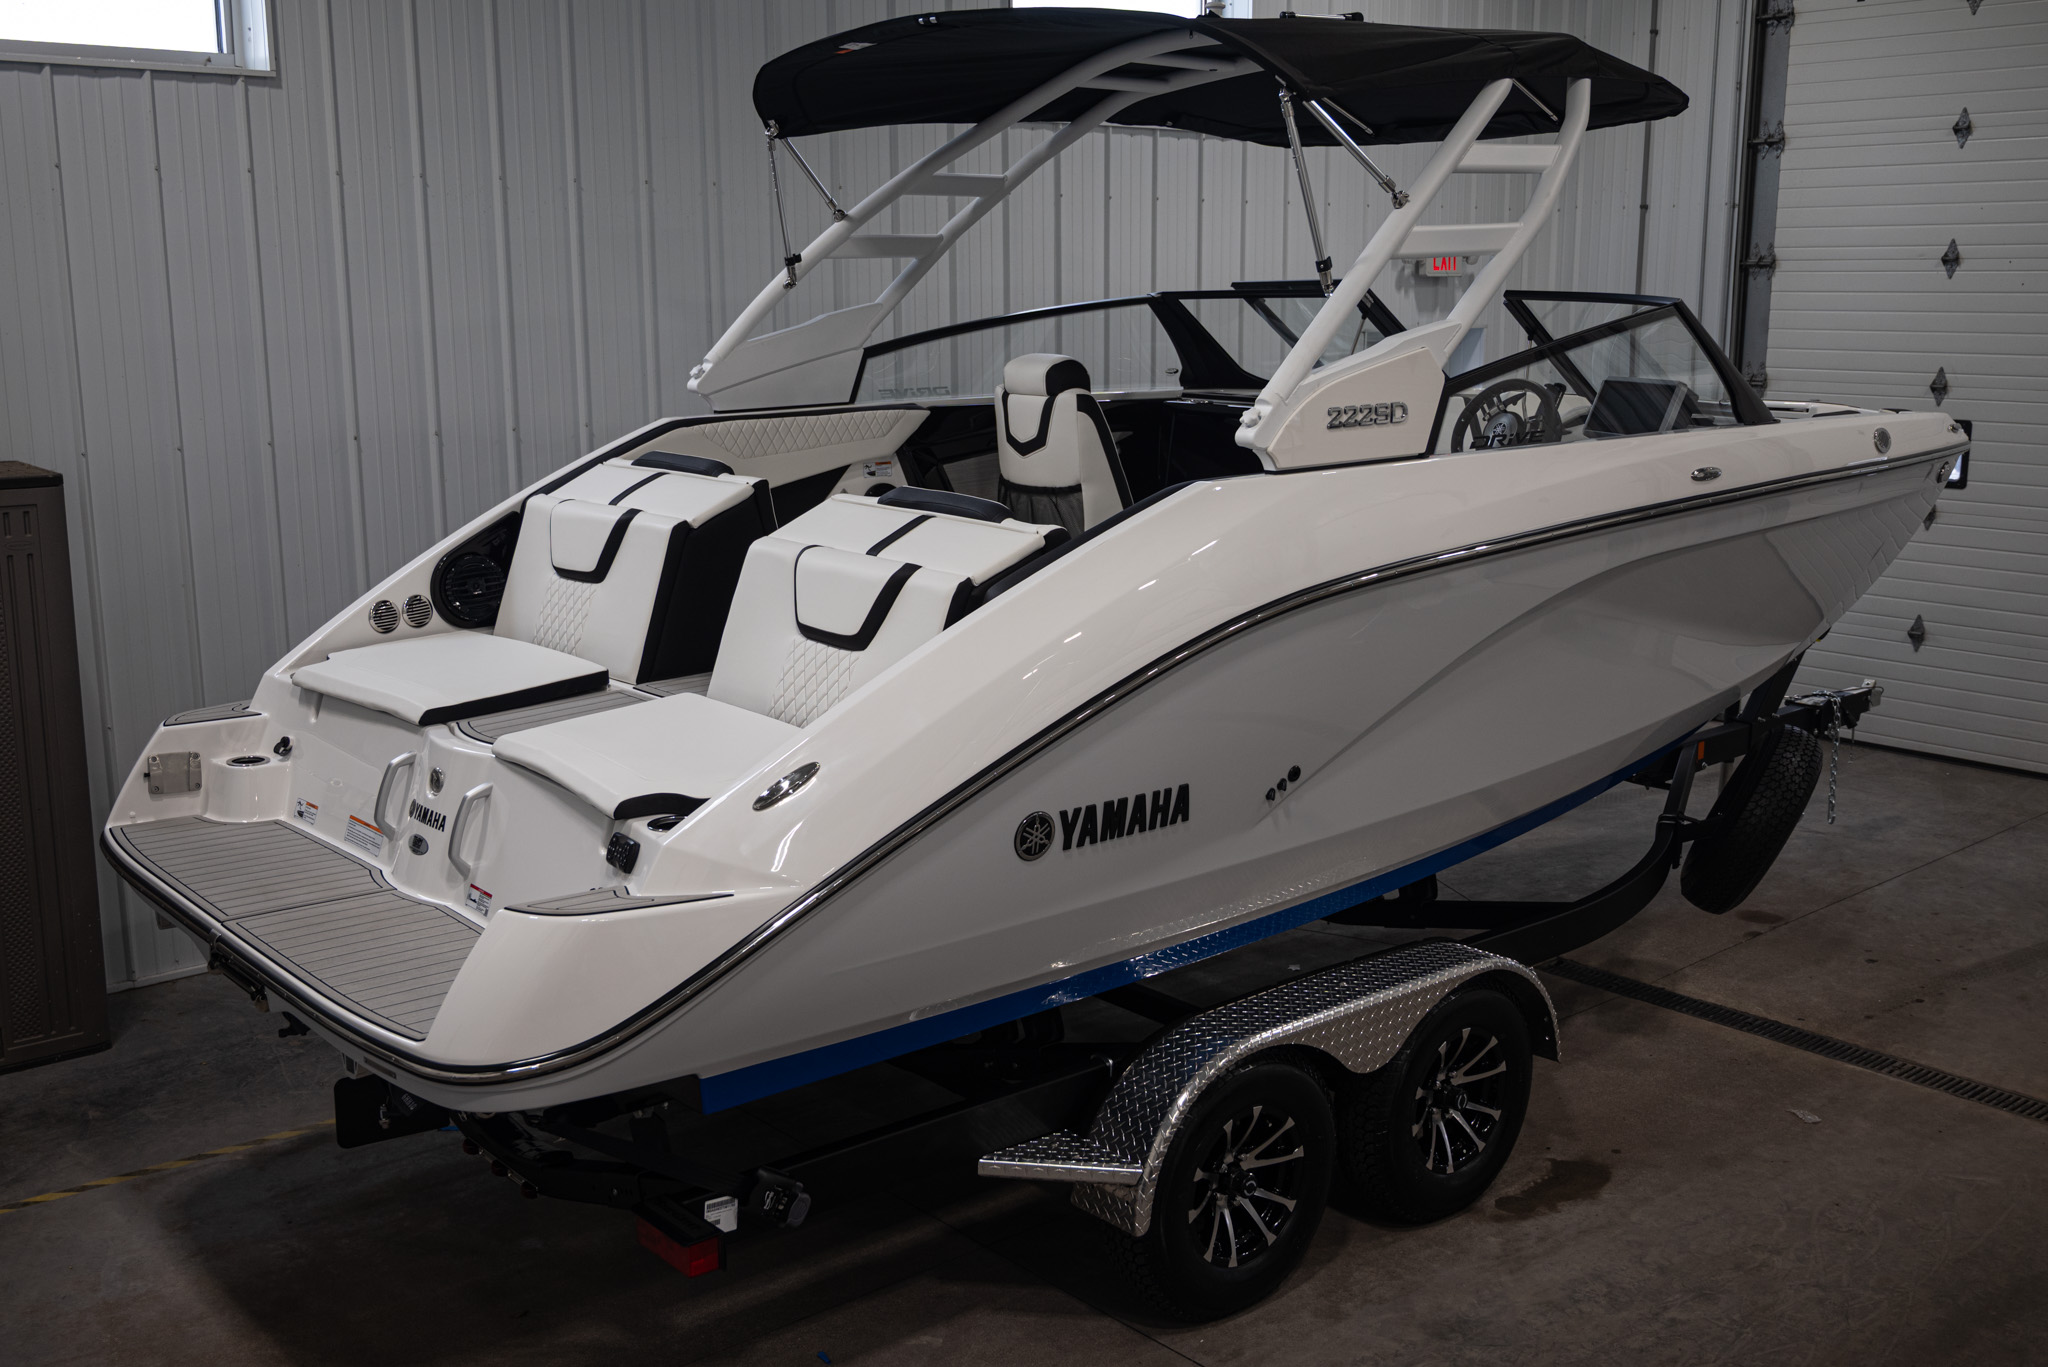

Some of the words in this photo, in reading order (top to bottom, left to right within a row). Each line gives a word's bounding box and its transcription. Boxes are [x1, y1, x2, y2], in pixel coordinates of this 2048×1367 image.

[1326, 401, 1409, 430] 222SD
[414, 803, 446, 832] YAMAHA
[1059, 783, 1190, 851] YAMAHA
